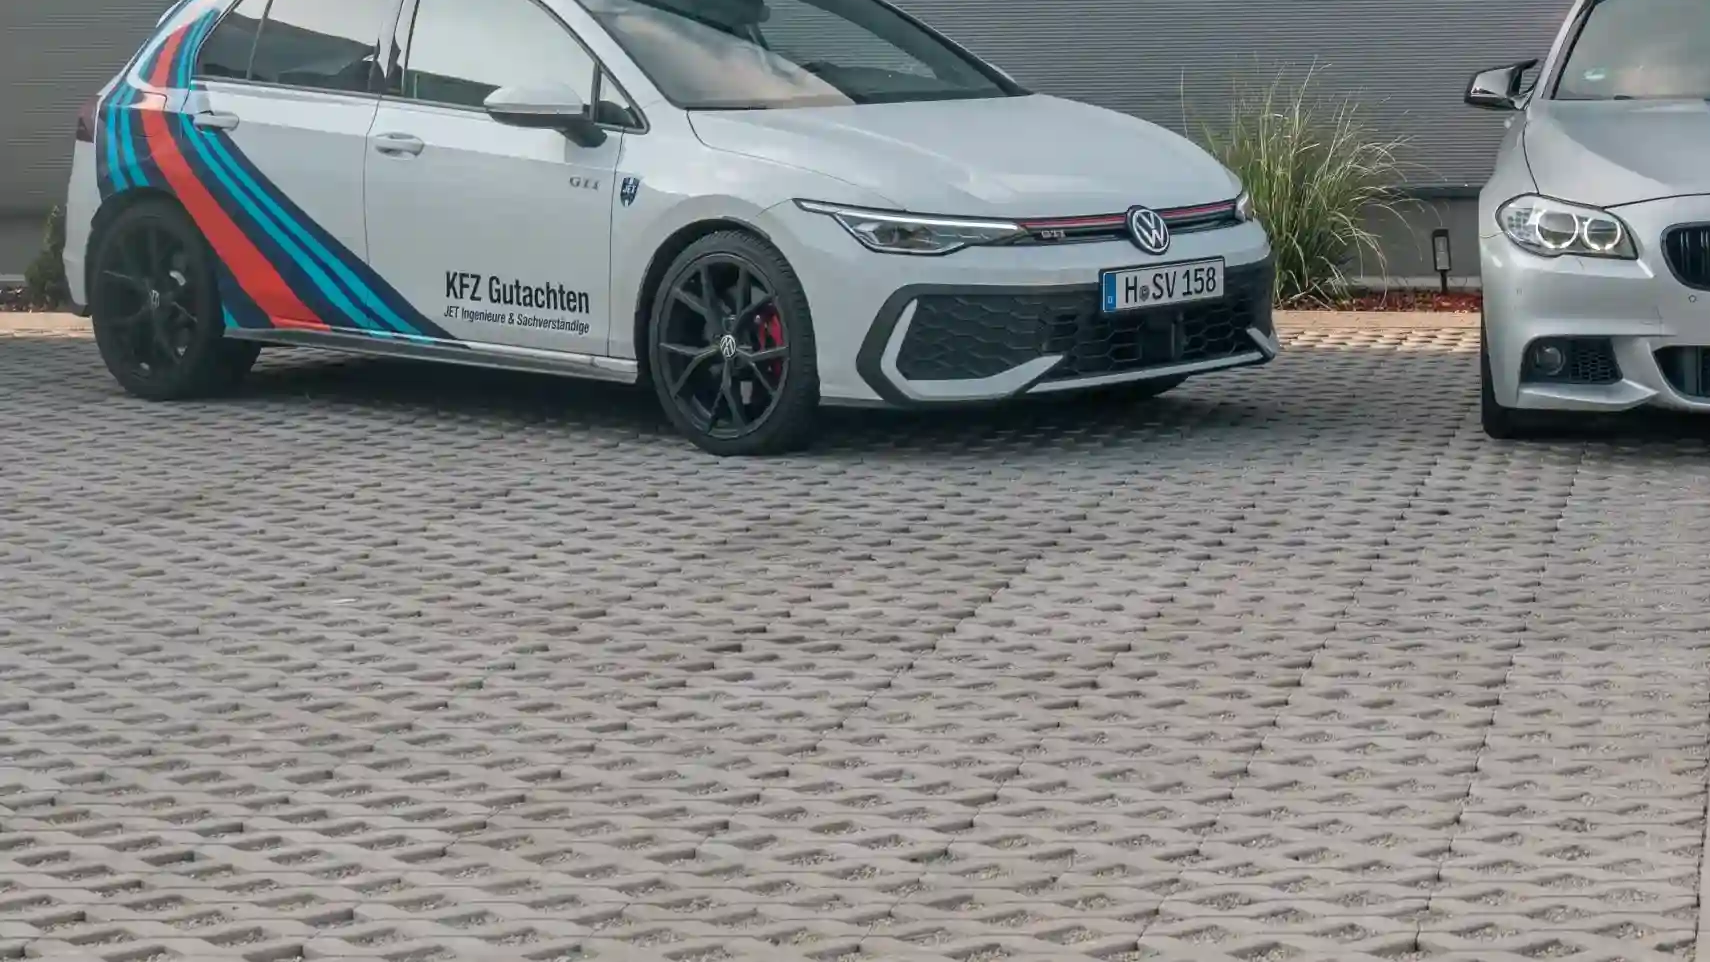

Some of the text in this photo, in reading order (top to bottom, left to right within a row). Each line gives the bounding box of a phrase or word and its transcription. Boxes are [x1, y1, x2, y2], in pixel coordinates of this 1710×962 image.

[445, 270, 590, 314] KFZ Gutachten
[1125, 276, 1137, 303] H
[1152, 272, 1176, 299] SV
[1182, 267, 1216, 296] 158
[444, 305, 590, 336] JET Ingenieure & Sachverständige
